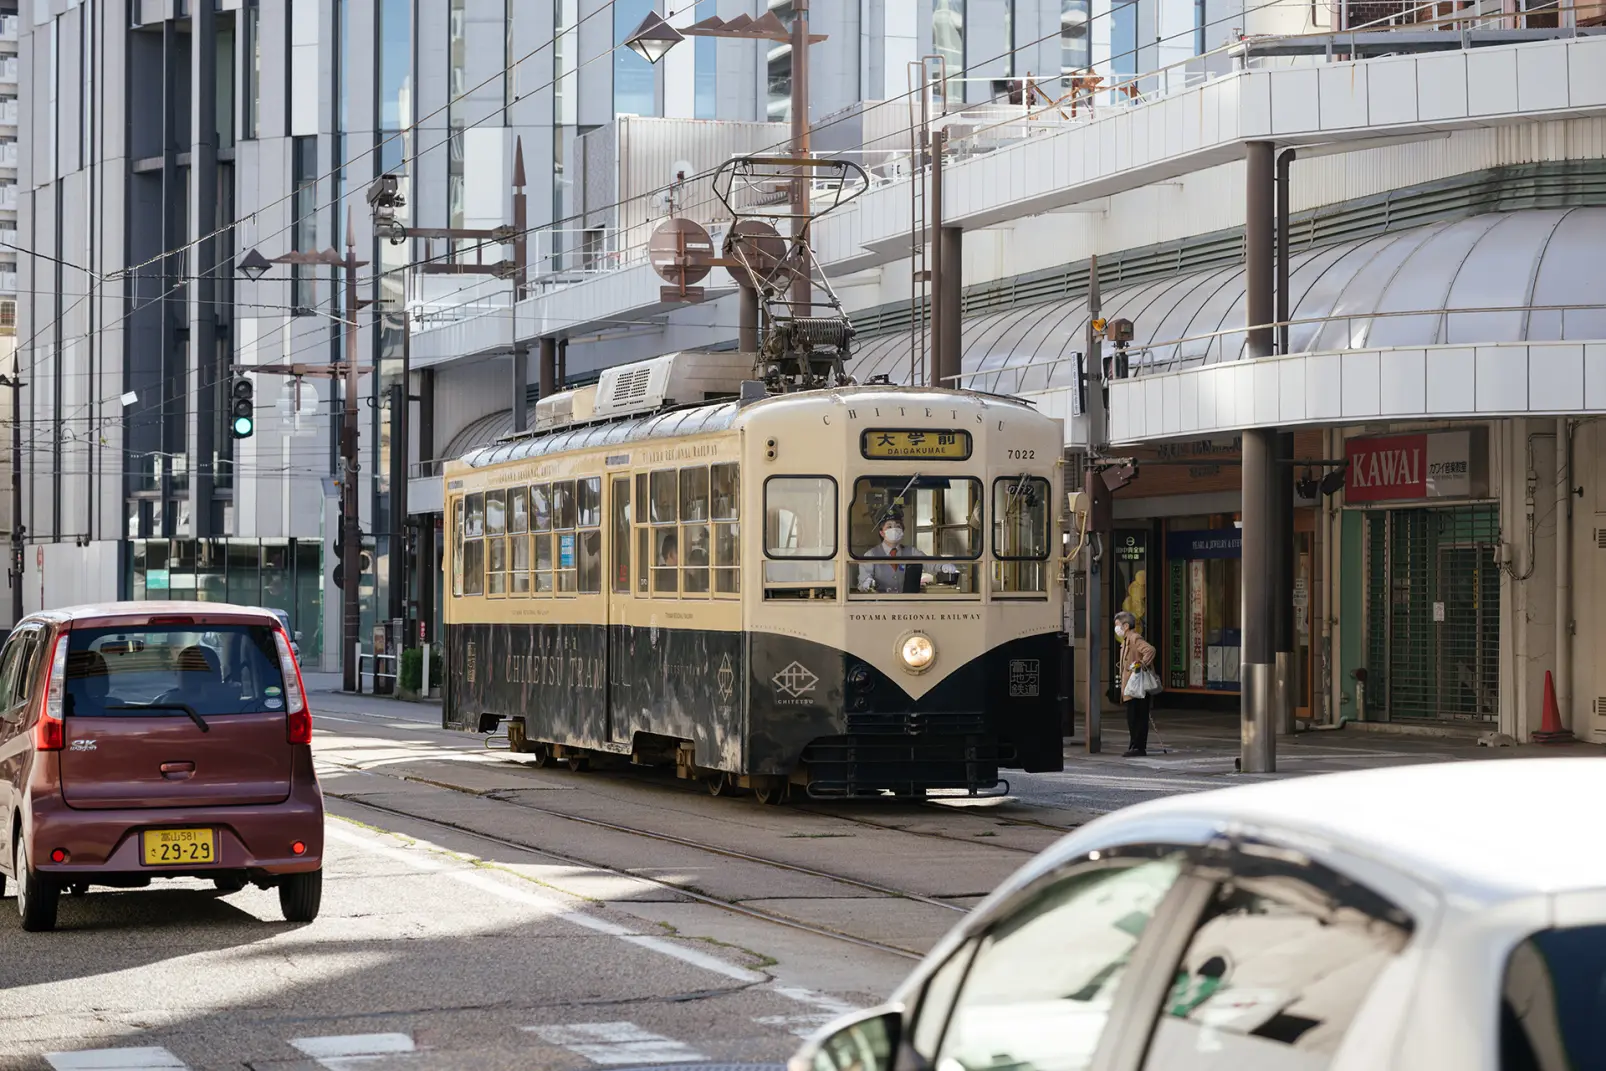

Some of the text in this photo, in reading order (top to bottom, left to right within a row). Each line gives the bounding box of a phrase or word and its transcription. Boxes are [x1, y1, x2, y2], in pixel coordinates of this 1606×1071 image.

[823, 406, 1006, 432] CHITETSU
[877, 431, 956, 447] 大学前
[887, 447, 946, 455] DAIGAKUMAE
[1007, 449, 1036, 460] 7022
[1352, 448, 1421, 488] KAWAI
[940, 613, 982, 621] RAILWAY
[505, 654, 564, 687] CHITETSU
[569, 656, 604, 689] TRAM
[160, 842, 210, 861] 29-29
